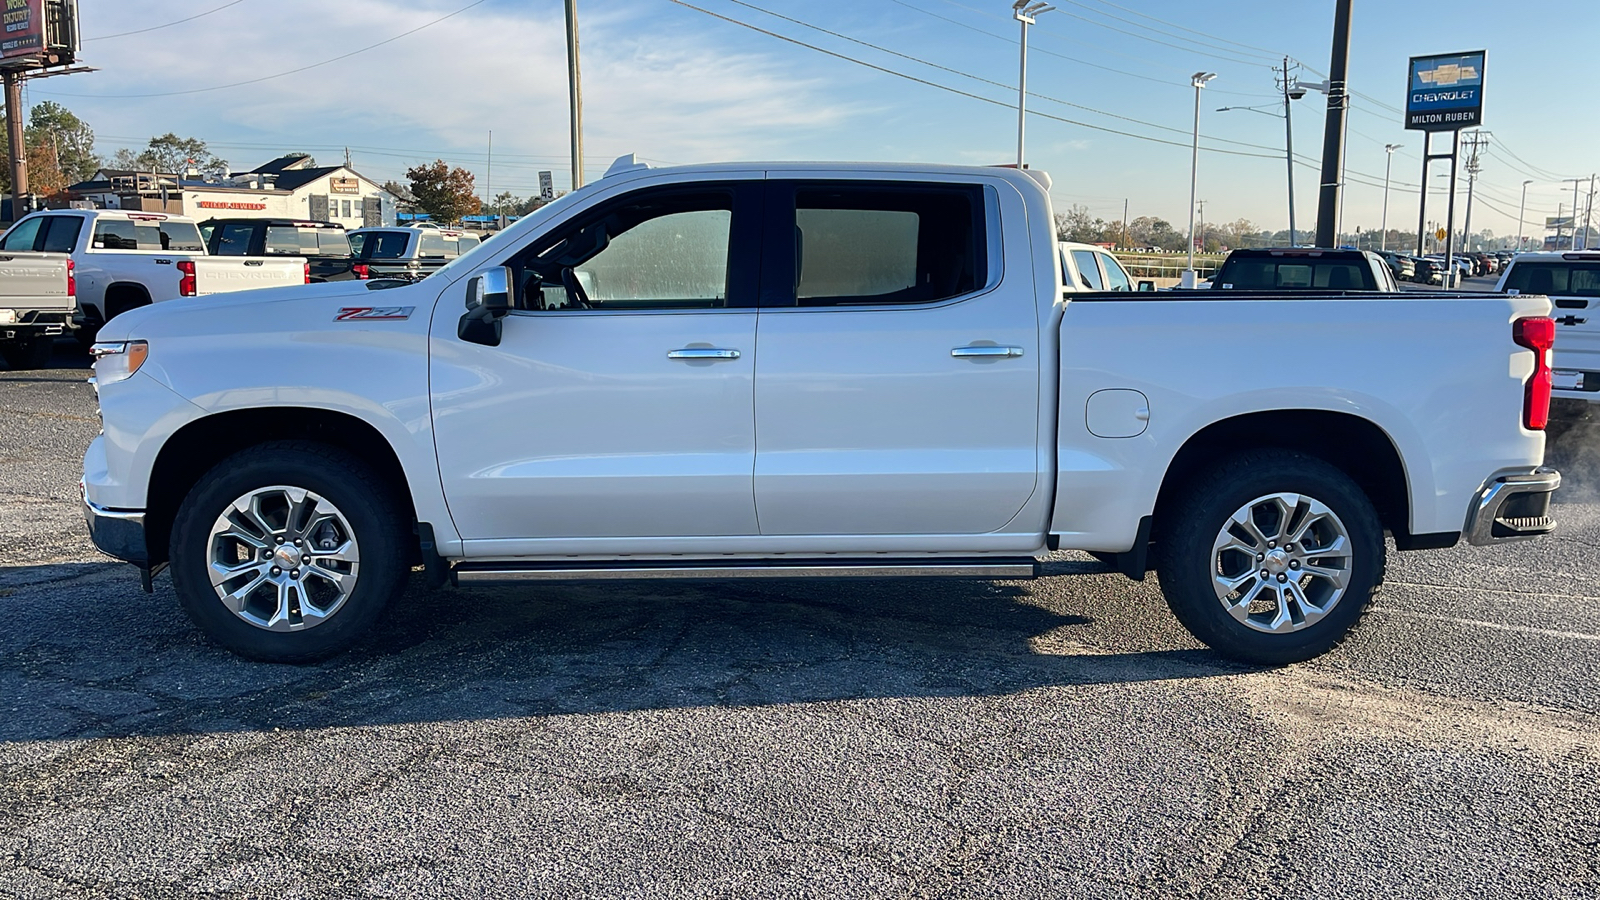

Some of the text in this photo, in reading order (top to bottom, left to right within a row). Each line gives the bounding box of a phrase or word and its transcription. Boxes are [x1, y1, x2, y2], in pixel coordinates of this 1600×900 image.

[1412, 90, 1475, 103] CHEVROLET
[1411, 112, 1475, 124] MILTON RUBEN
[541, 187, 553, 199] 45
[333, 306, 416, 322] Z71
